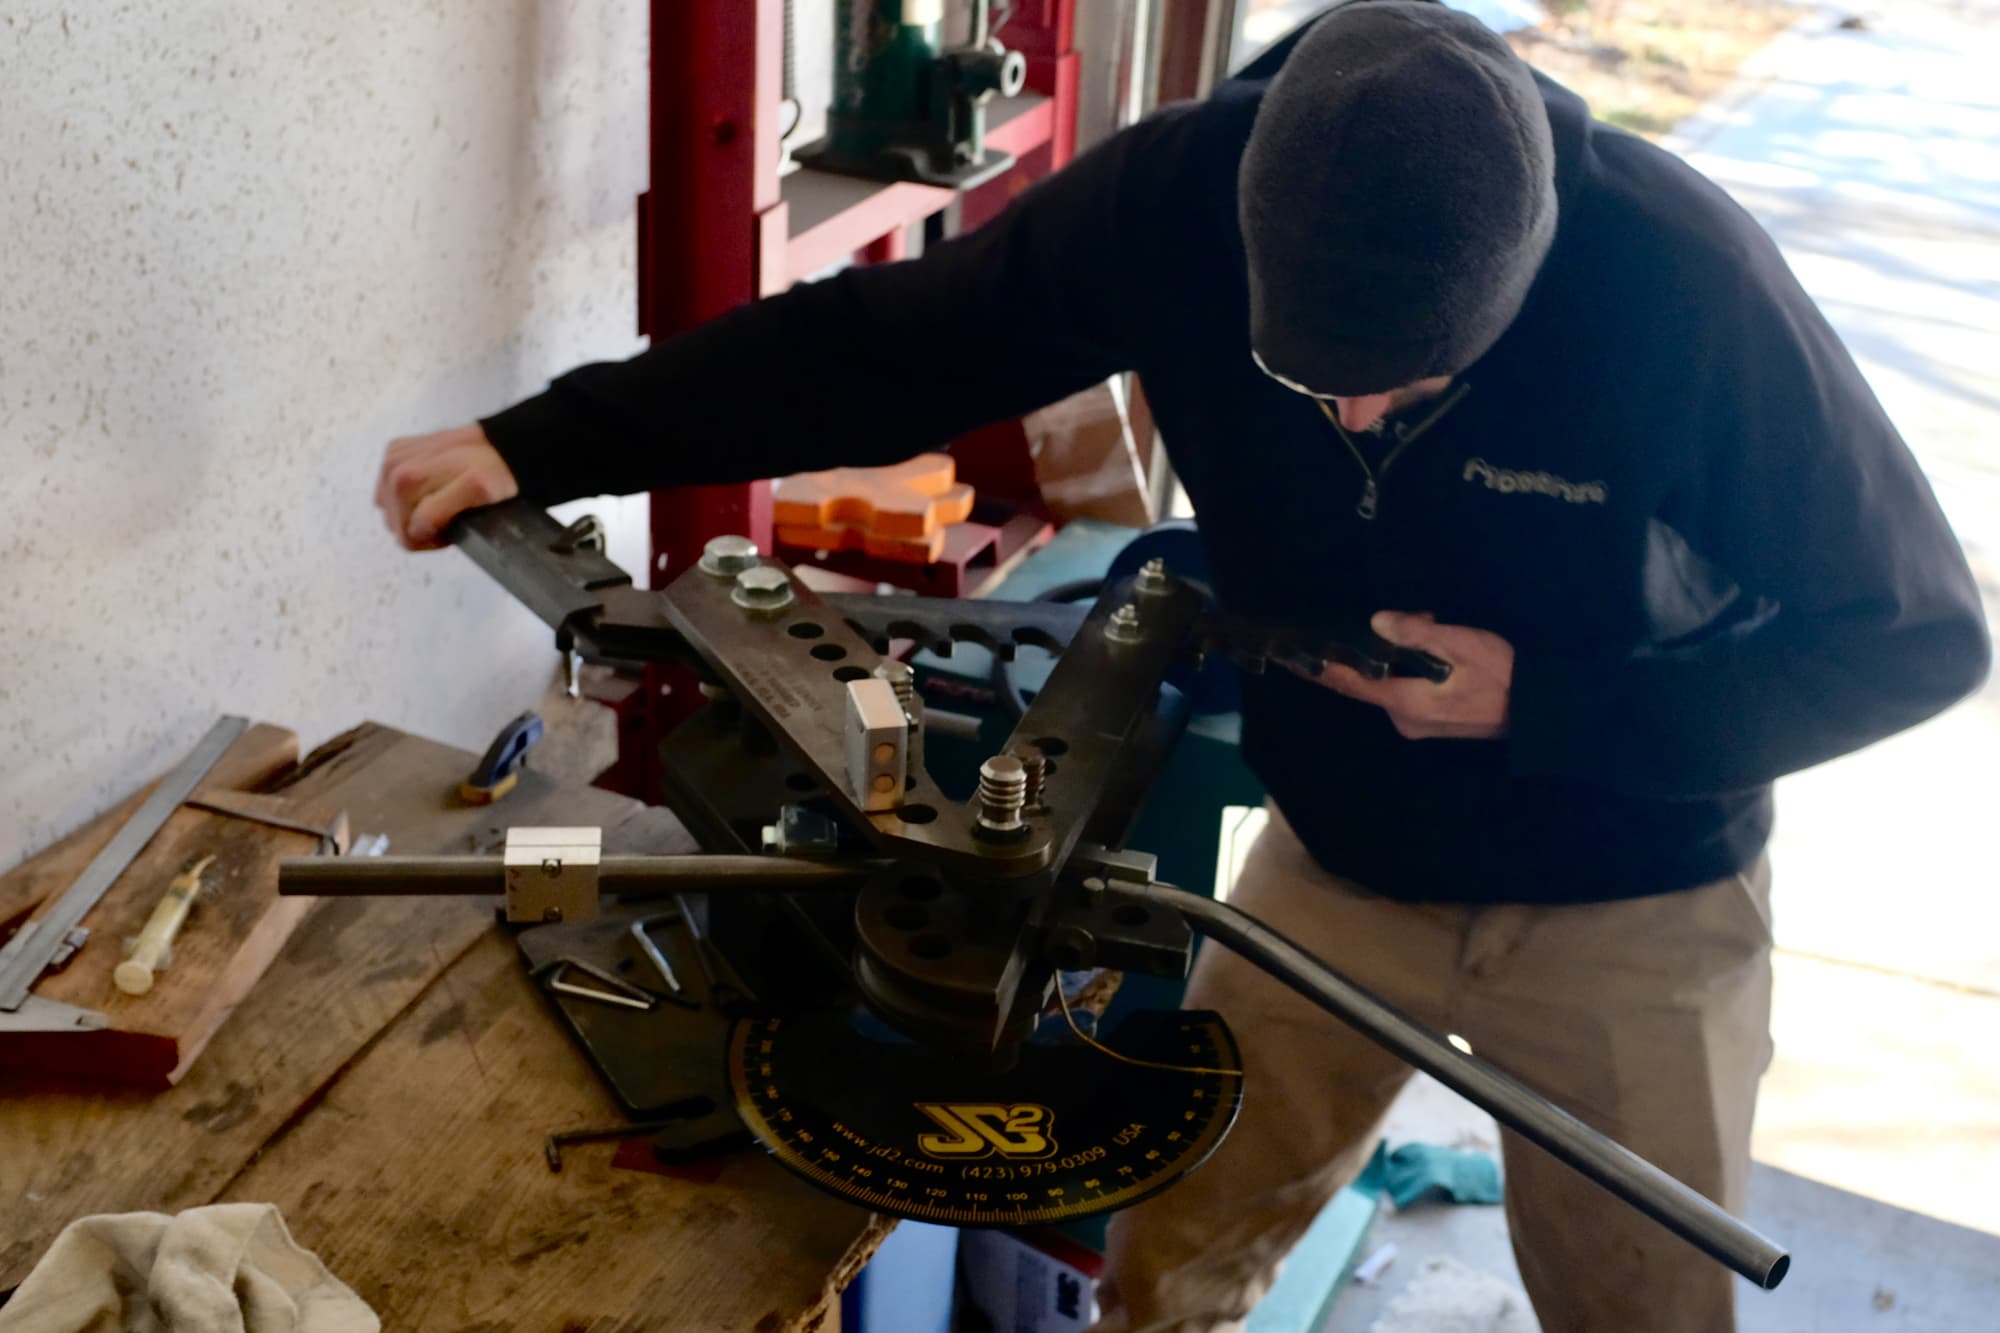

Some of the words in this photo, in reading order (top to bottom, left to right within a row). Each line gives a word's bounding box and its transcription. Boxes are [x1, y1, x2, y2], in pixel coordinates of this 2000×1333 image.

[961, 1165, 1015, 1182] (423)
[1018, 1144, 1107, 1178] 979-0309
[1112, 1121, 1149, 1147] USA
[965, 1191, 988, 1201] 110
[1005, 1191, 1029, 1201] 100
